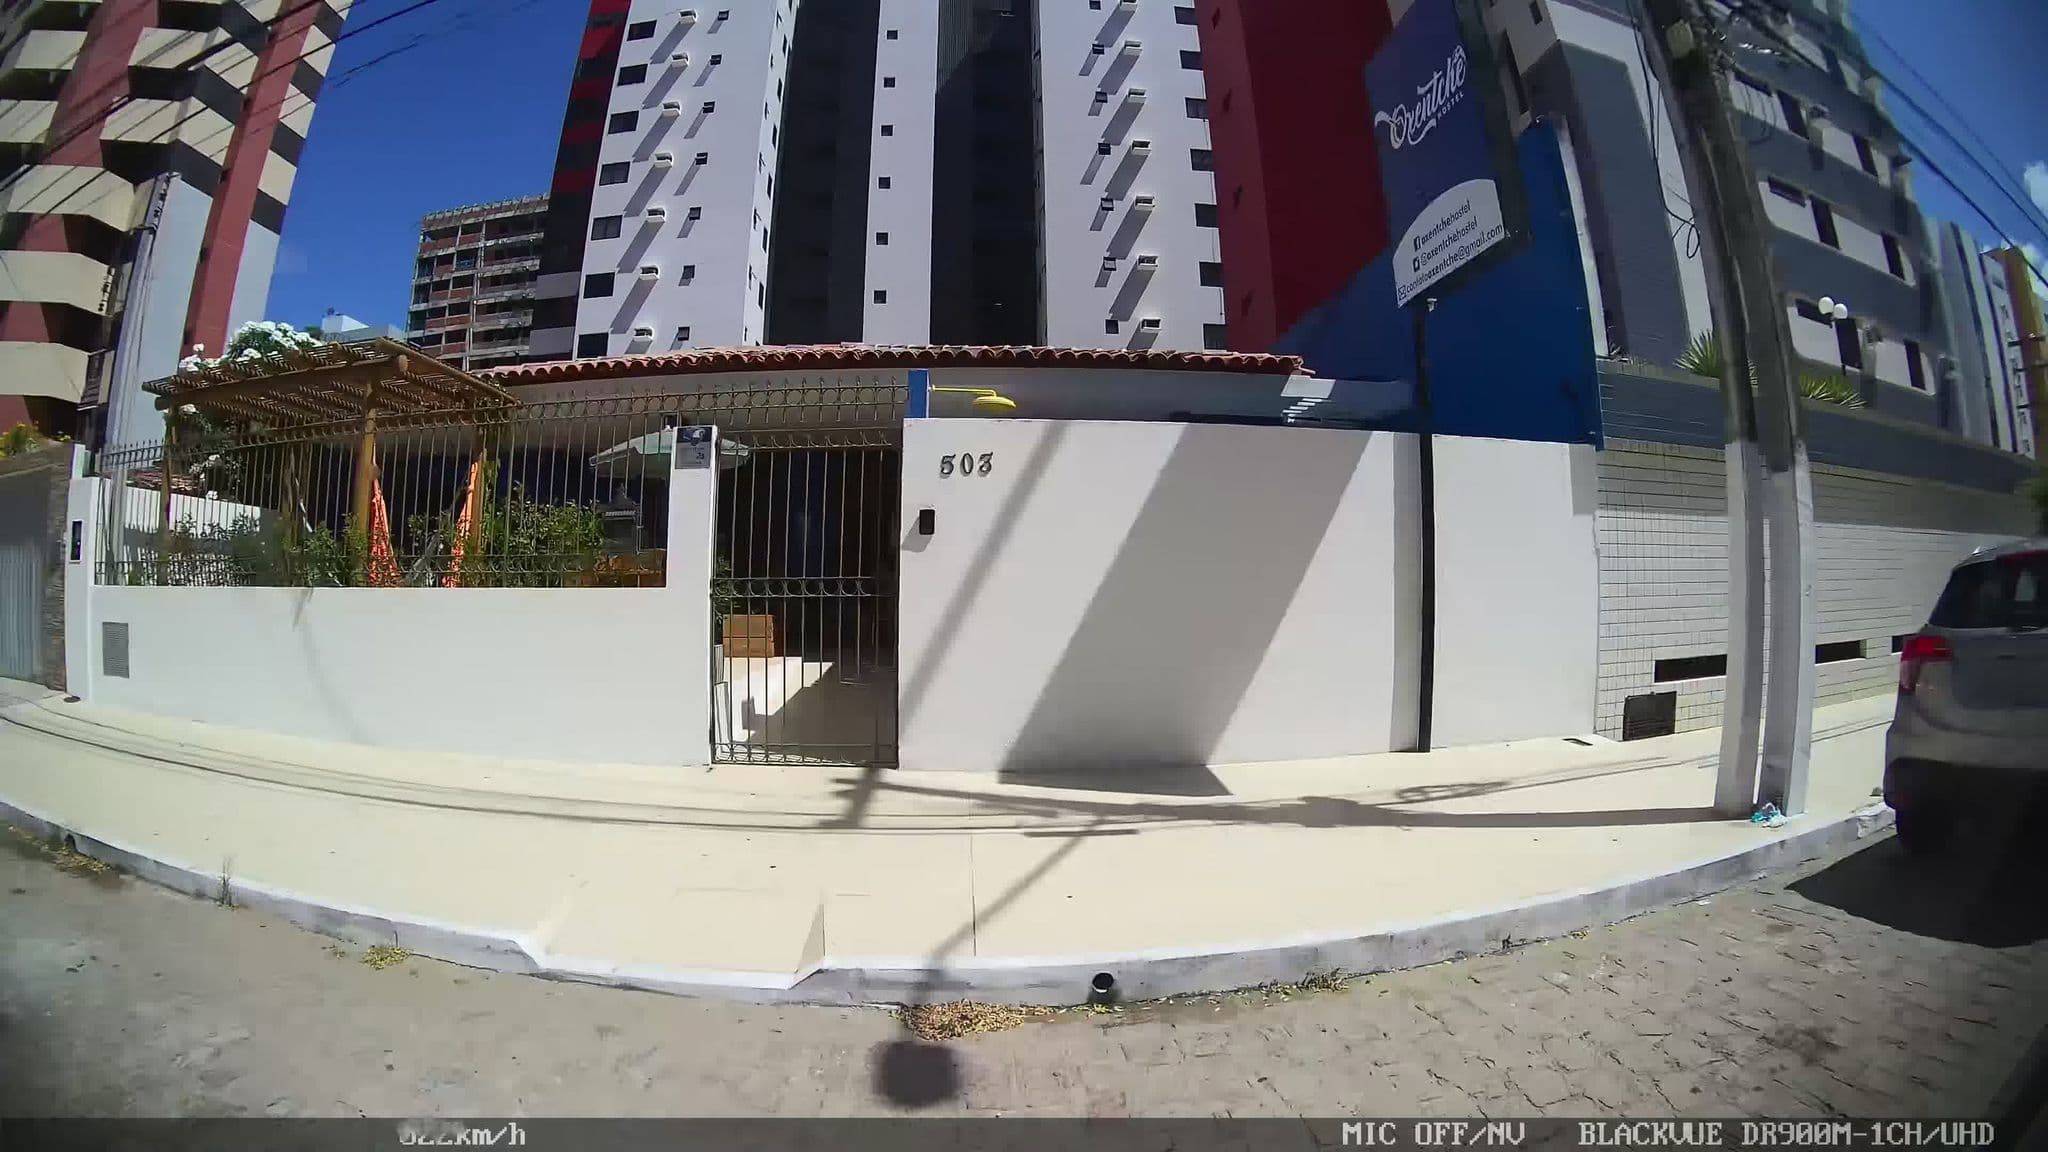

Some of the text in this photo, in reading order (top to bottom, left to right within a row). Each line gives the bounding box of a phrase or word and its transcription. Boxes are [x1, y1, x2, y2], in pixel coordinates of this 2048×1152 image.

[1437, 91, 1464, 120] HOSTEL
[1421, 199, 1471, 246] oxentchehostel
[940, 452, 993, 477] 503
